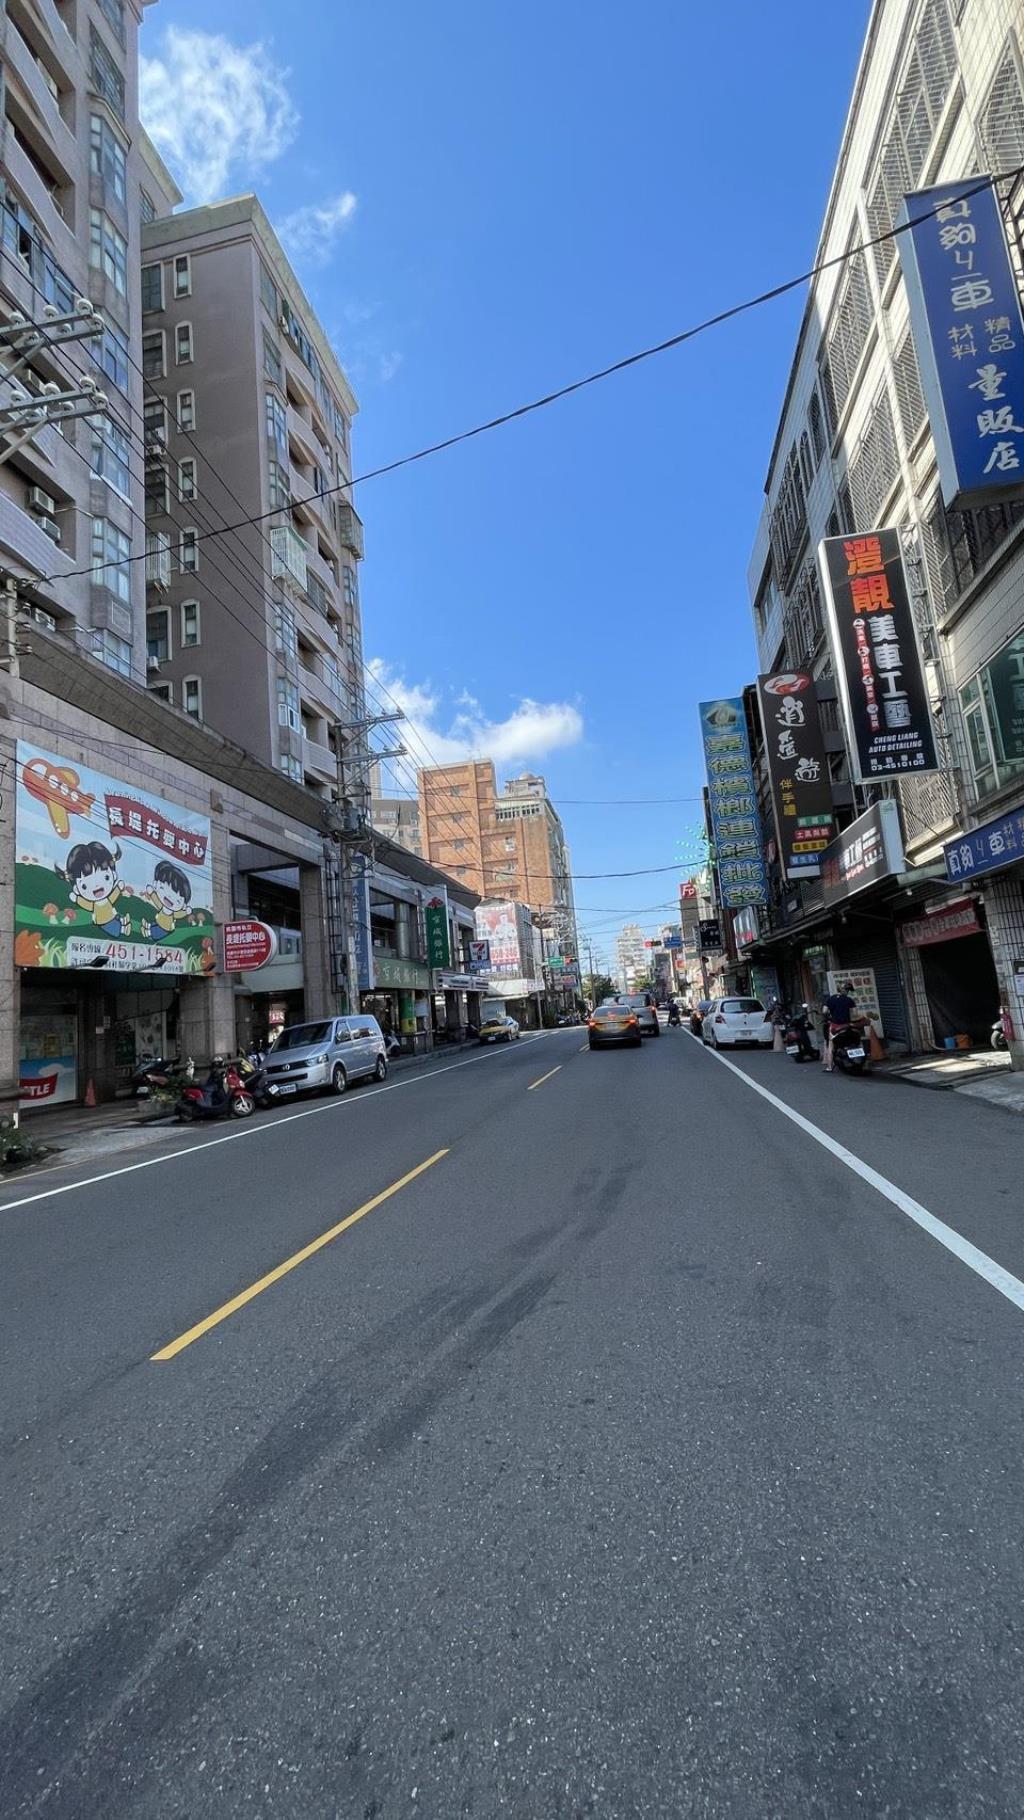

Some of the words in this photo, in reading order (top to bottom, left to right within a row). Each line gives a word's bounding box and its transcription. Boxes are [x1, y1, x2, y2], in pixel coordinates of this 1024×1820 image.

[948, 323, 978, 361] 材料
[984, 317, 1016, 353] 精品
[968, 363, 1024, 474] 量販店
[887, 740, 922, 751] DETAILING
[898, 732, 918, 741] LIANG
[106, 943, 182, 964] 451-1584
